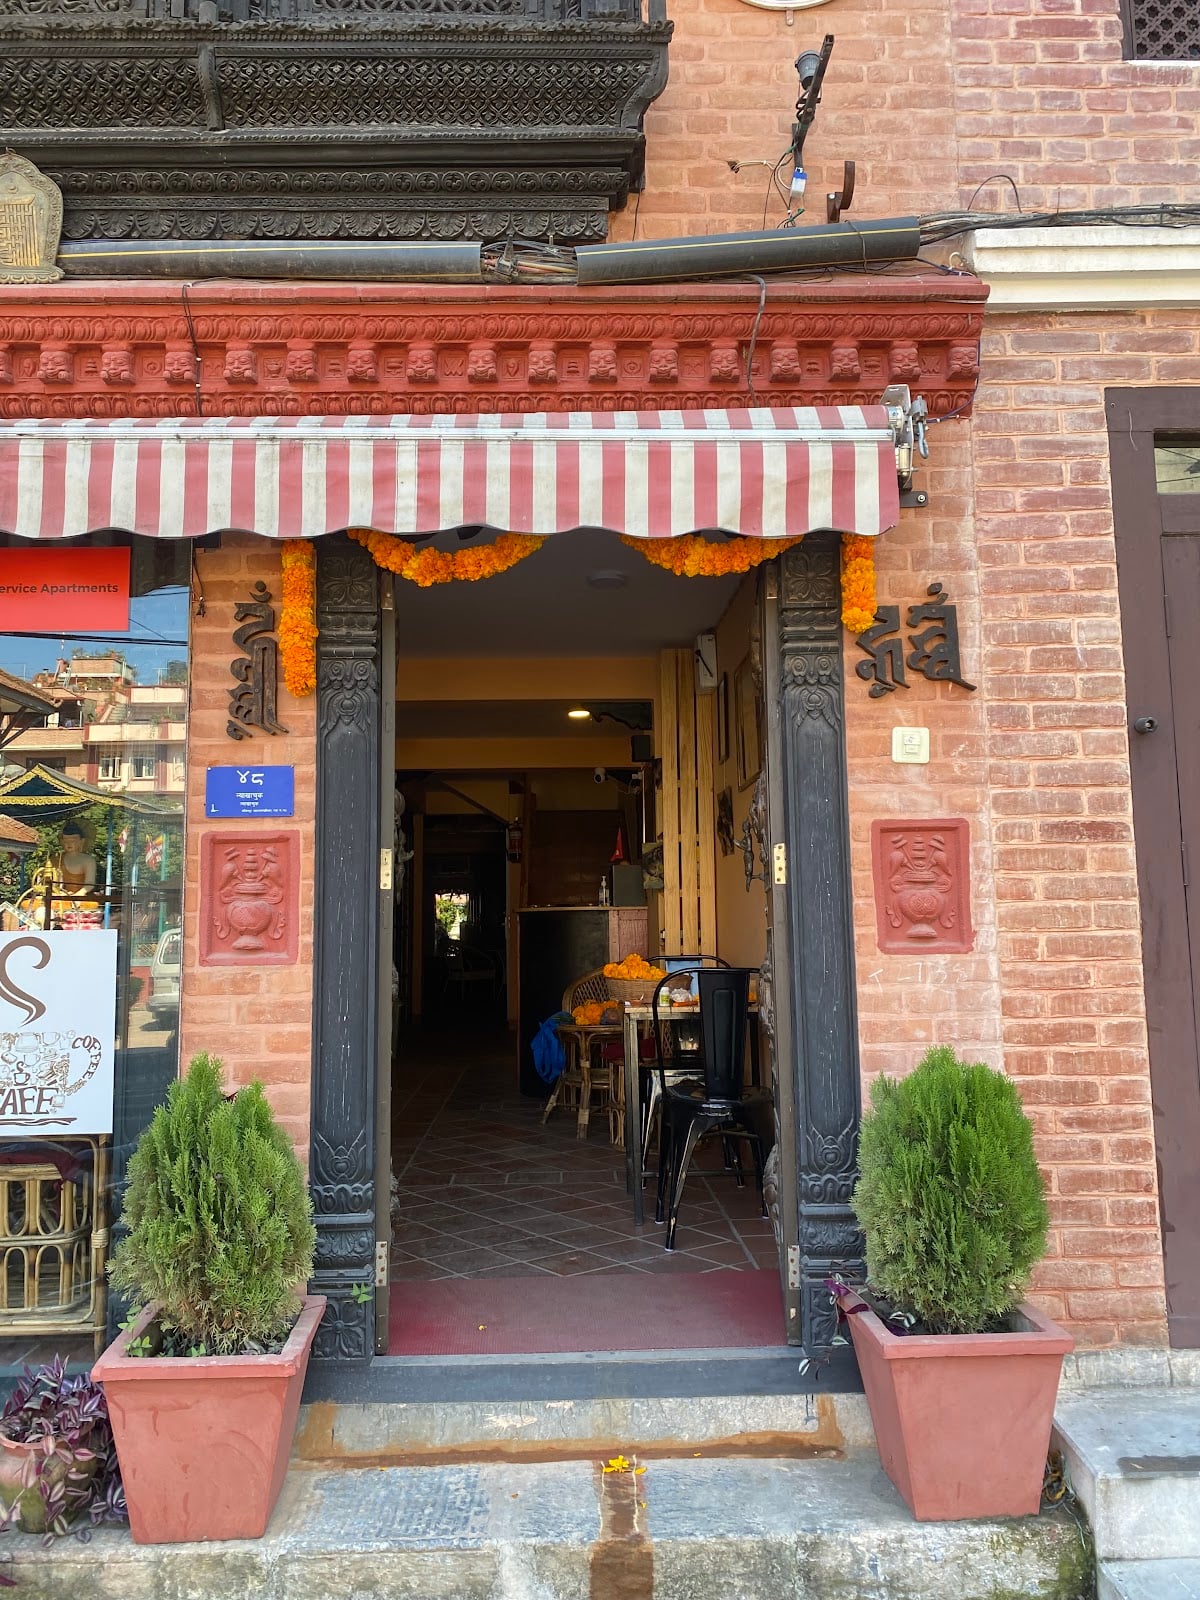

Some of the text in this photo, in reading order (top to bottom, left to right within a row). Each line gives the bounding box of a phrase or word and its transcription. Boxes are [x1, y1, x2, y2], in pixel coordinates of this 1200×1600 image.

[40, 584, 119, 595] Apartments
[71, 1035, 102, 1080] COFFEE
[0, 1086, 59, 1115] AFE
